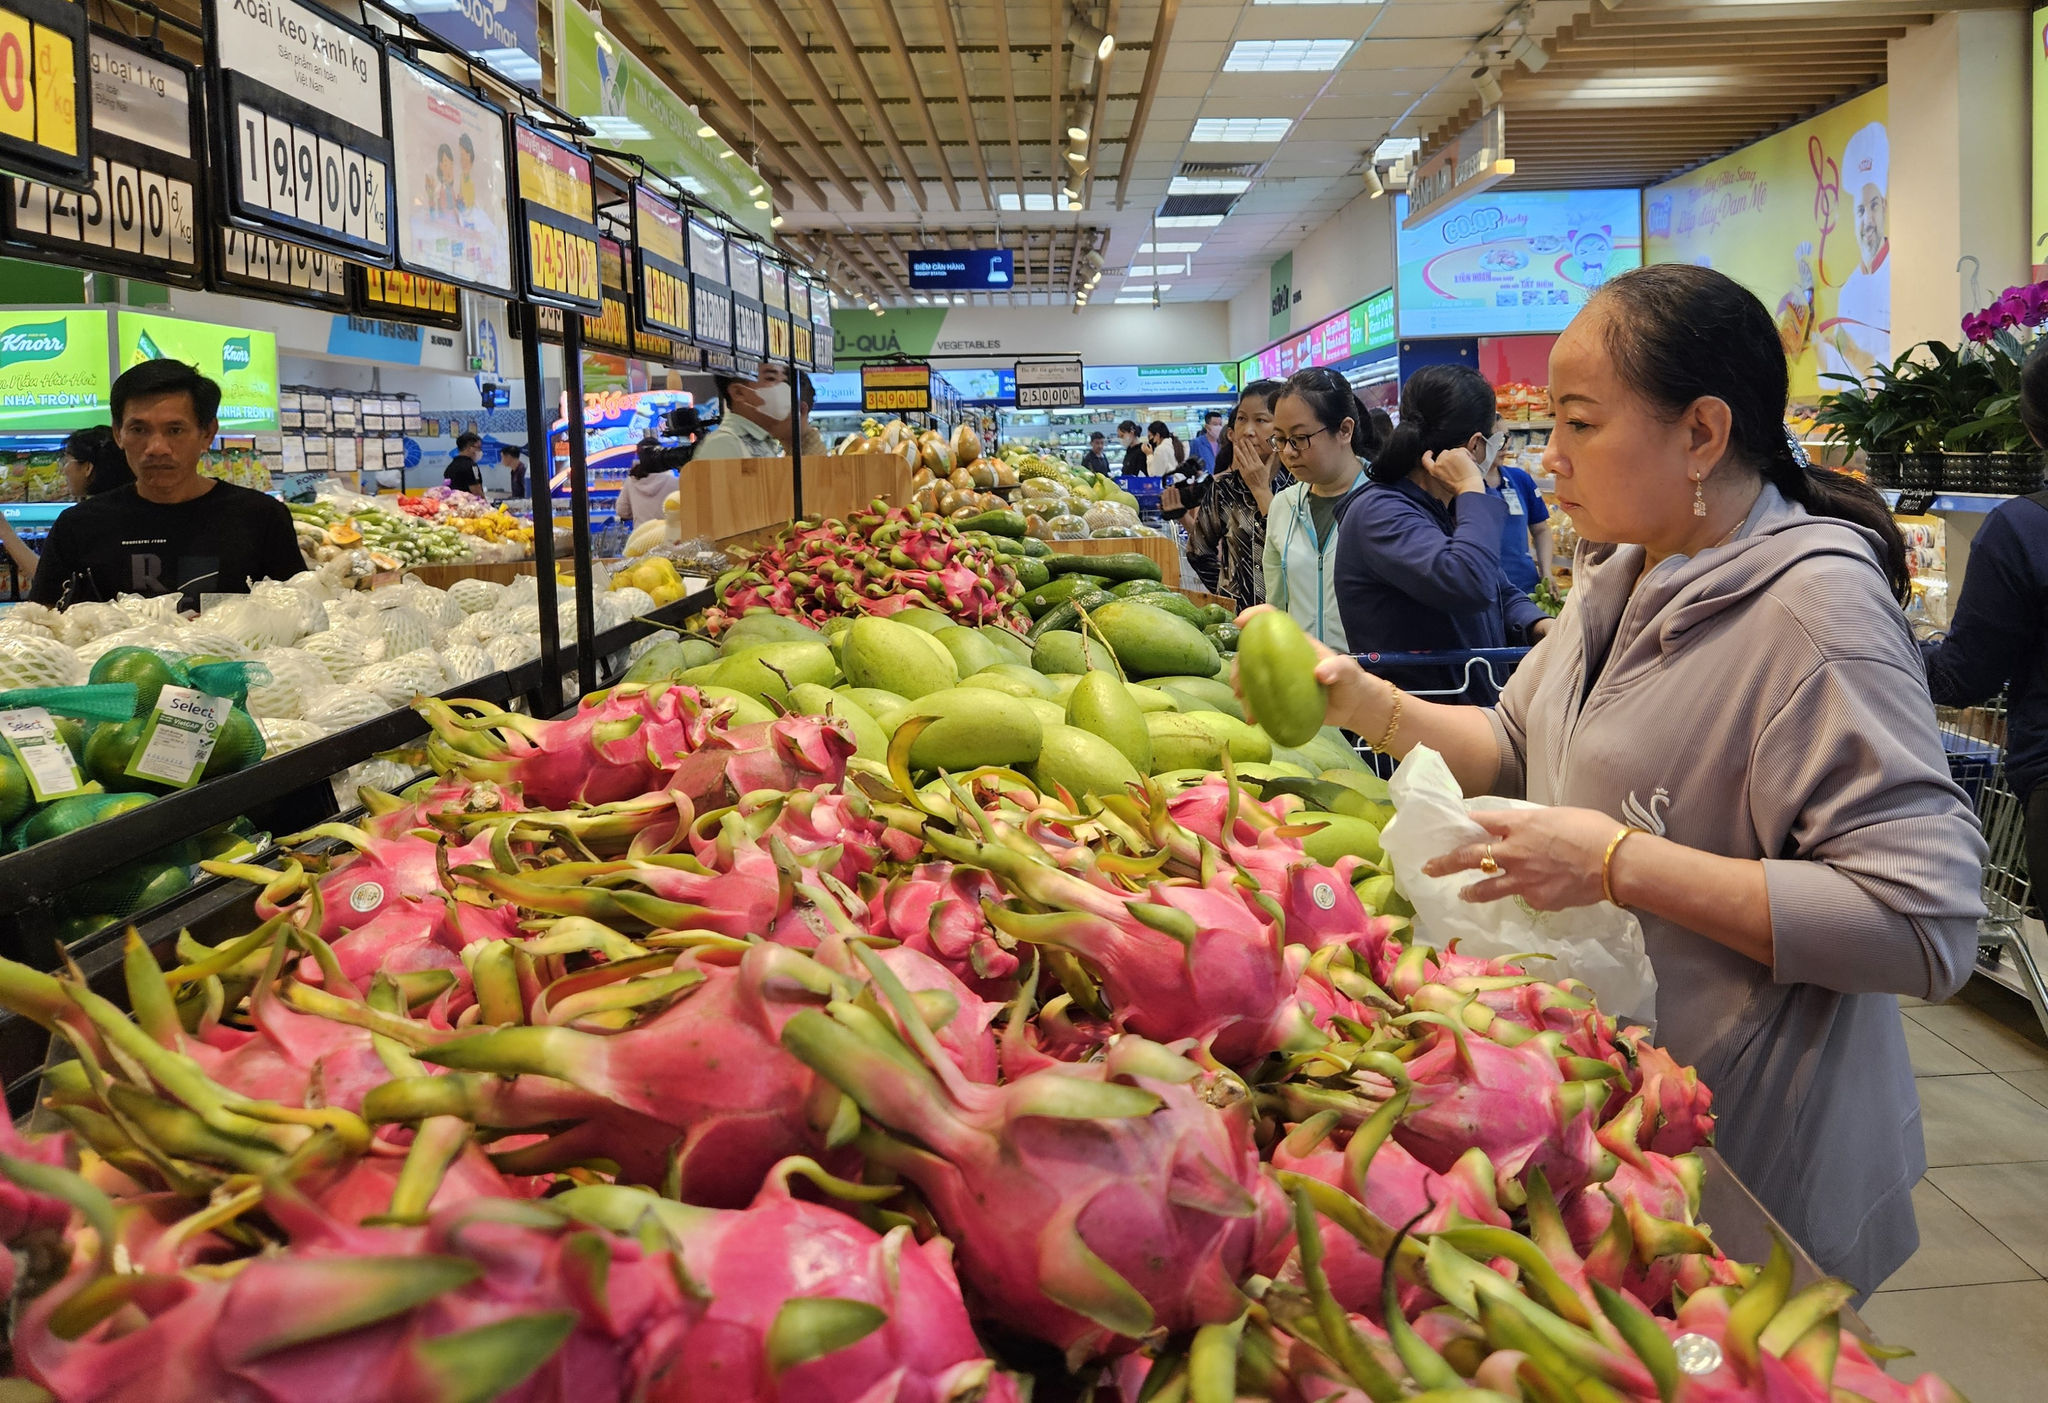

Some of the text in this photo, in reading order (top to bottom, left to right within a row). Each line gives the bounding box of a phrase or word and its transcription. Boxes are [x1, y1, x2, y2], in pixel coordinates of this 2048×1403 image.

[278, 7, 307, 45] keo
[311, 31, 347, 67] xanh
[351, 47, 368, 83] kg
[106, 52, 132, 83] loại
[136, 66, 143, 85] 1
[150, 71, 165, 97] kg
[294, 69, 325, 94] Việt Nam
[246, 119, 385, 230] 19.900 đ/kg
[171, 190, 192, 244] đ/kg
[0, 333, 64, 351] Knorr
[937, 340, 1001, 350] VEGETABLES
[223, 345, 249, 362] Knorr
[1022, 389, 1069, 403] 25.000
[1085, 380, 1111, 391] lect
[4, 391, 98, 407] NHÀ TRÒN VỊ
[131, 553, 168, 592] R
[170, 698, 214, 719] Select
